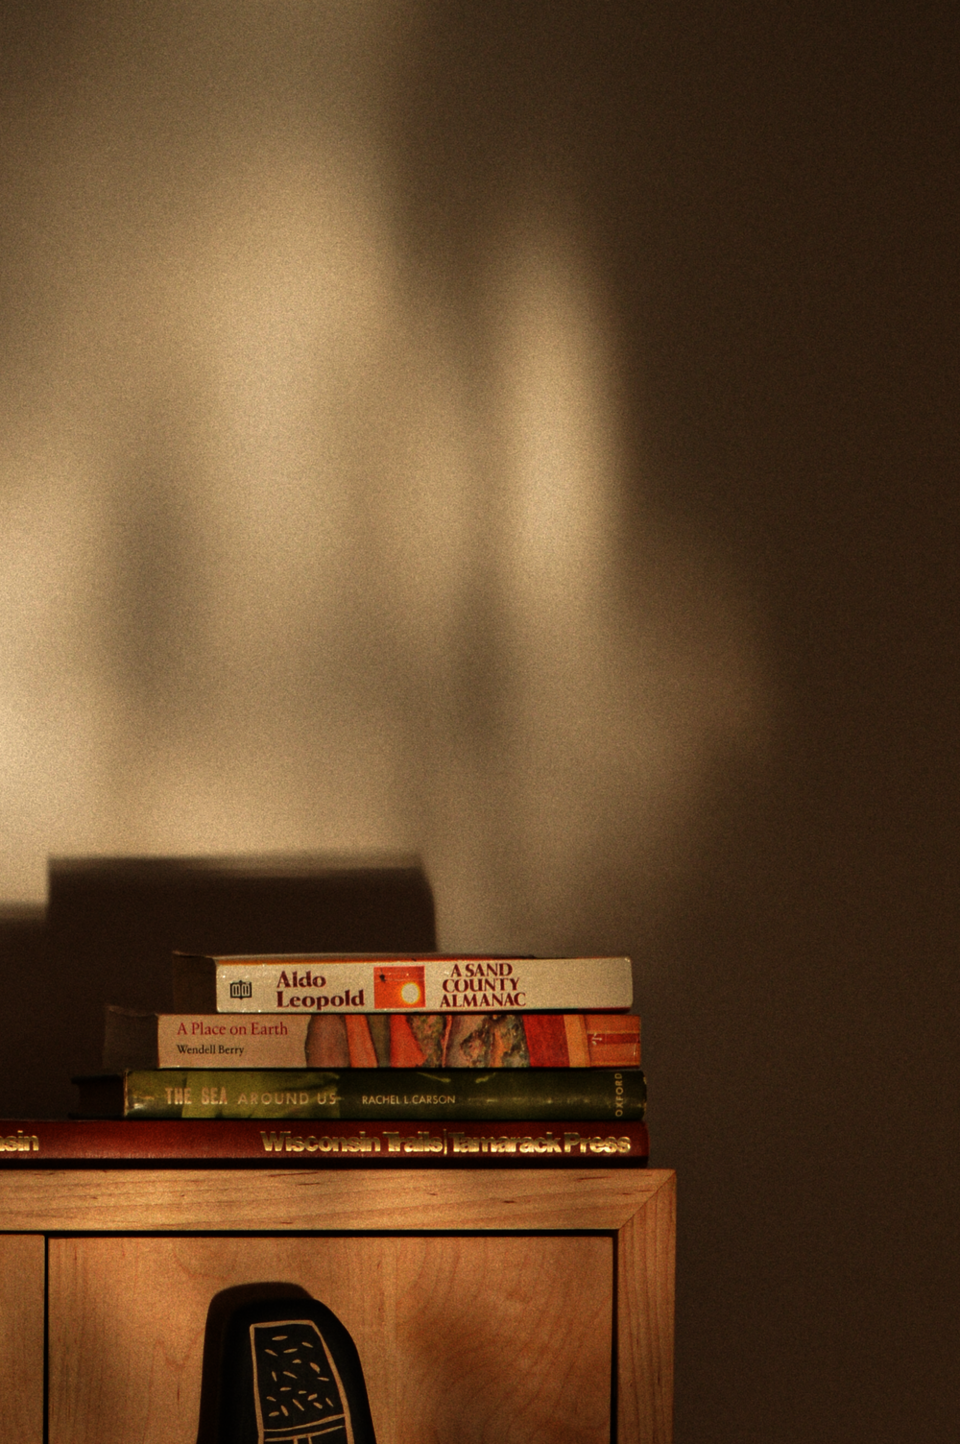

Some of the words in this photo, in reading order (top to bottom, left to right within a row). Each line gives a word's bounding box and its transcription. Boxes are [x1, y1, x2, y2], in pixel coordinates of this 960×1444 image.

[450, 964, 462, 977] A
[465, 963, 513, 977] SAND
[276, 970, 327, 989] Aldo
[442, 977, 520, 993] COUNTY
[276, 989, 365, 1010] Leopold
[440, 992, 526, 1008] ALMANAC
[177, 1022, 187, 1035] A
[191, 1022, 226, 1035] Place
[229, 1027, 247, 1035] on
[251, 1021, 288, 1035] Earth
[176, 1045, 216, 1055] Wendell
[218, 1045, 245, 1056] Berry
[165, 1087, 192, 1105] THE
[201, 1086, 228, 1105] SEA
[237, 1092, 310, 1105] AROUND
[317, 1092, 337, 1105] US
[361, 1095, 401, 1105] RACHEL
[411, 1094, 456, 1105] CARSON
[614, 1073, 624, 1117] OXFORD
[260, 1130, 381, 1153] Wisconsin
[564, 1132, 632, 1154] Press
